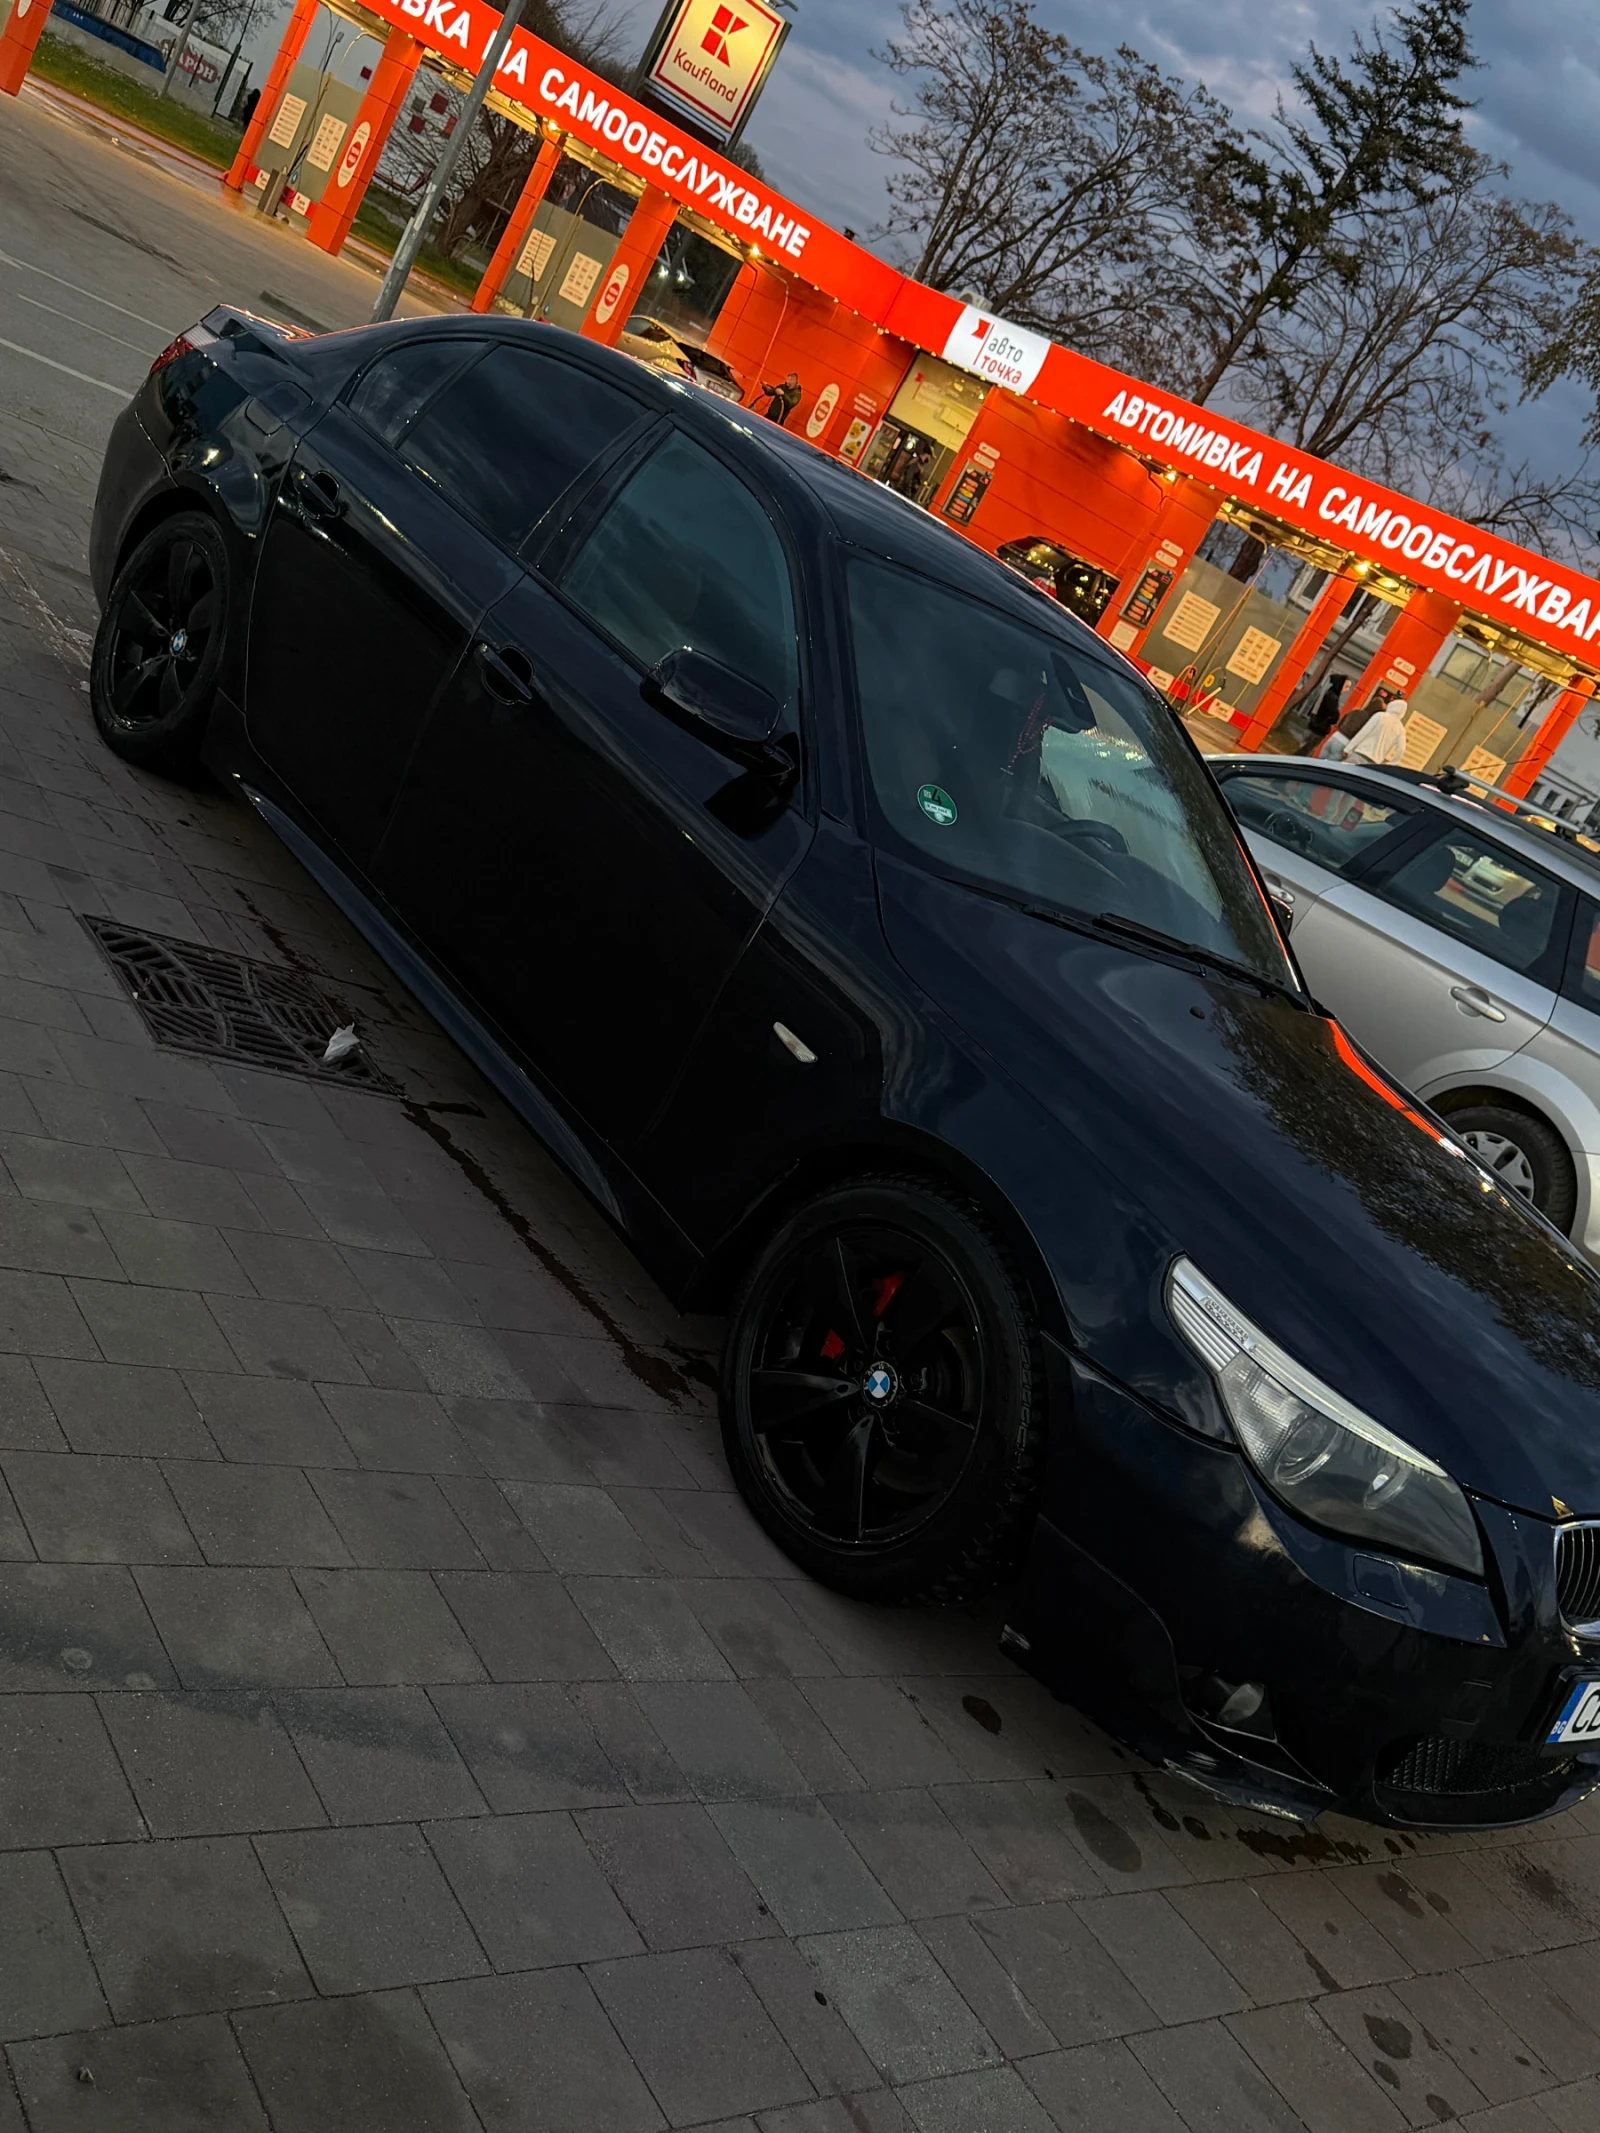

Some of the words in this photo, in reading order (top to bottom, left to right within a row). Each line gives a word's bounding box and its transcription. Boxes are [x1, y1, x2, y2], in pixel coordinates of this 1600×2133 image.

[673, 48, 738, 103] Kaufland
[391, 0, 470, 49] ВКА
[540, 69, 811, 257] САМООБСЛУЖВАНЕ
[980, 355, 1023, 384] точка
[988, 337, 1024, 363] авто
[1103, 390, 1263, 485] АВТОМИВКА
[1266, 462, 1313, 508] НА
[1550, 1720, 1567, 1735] BG
